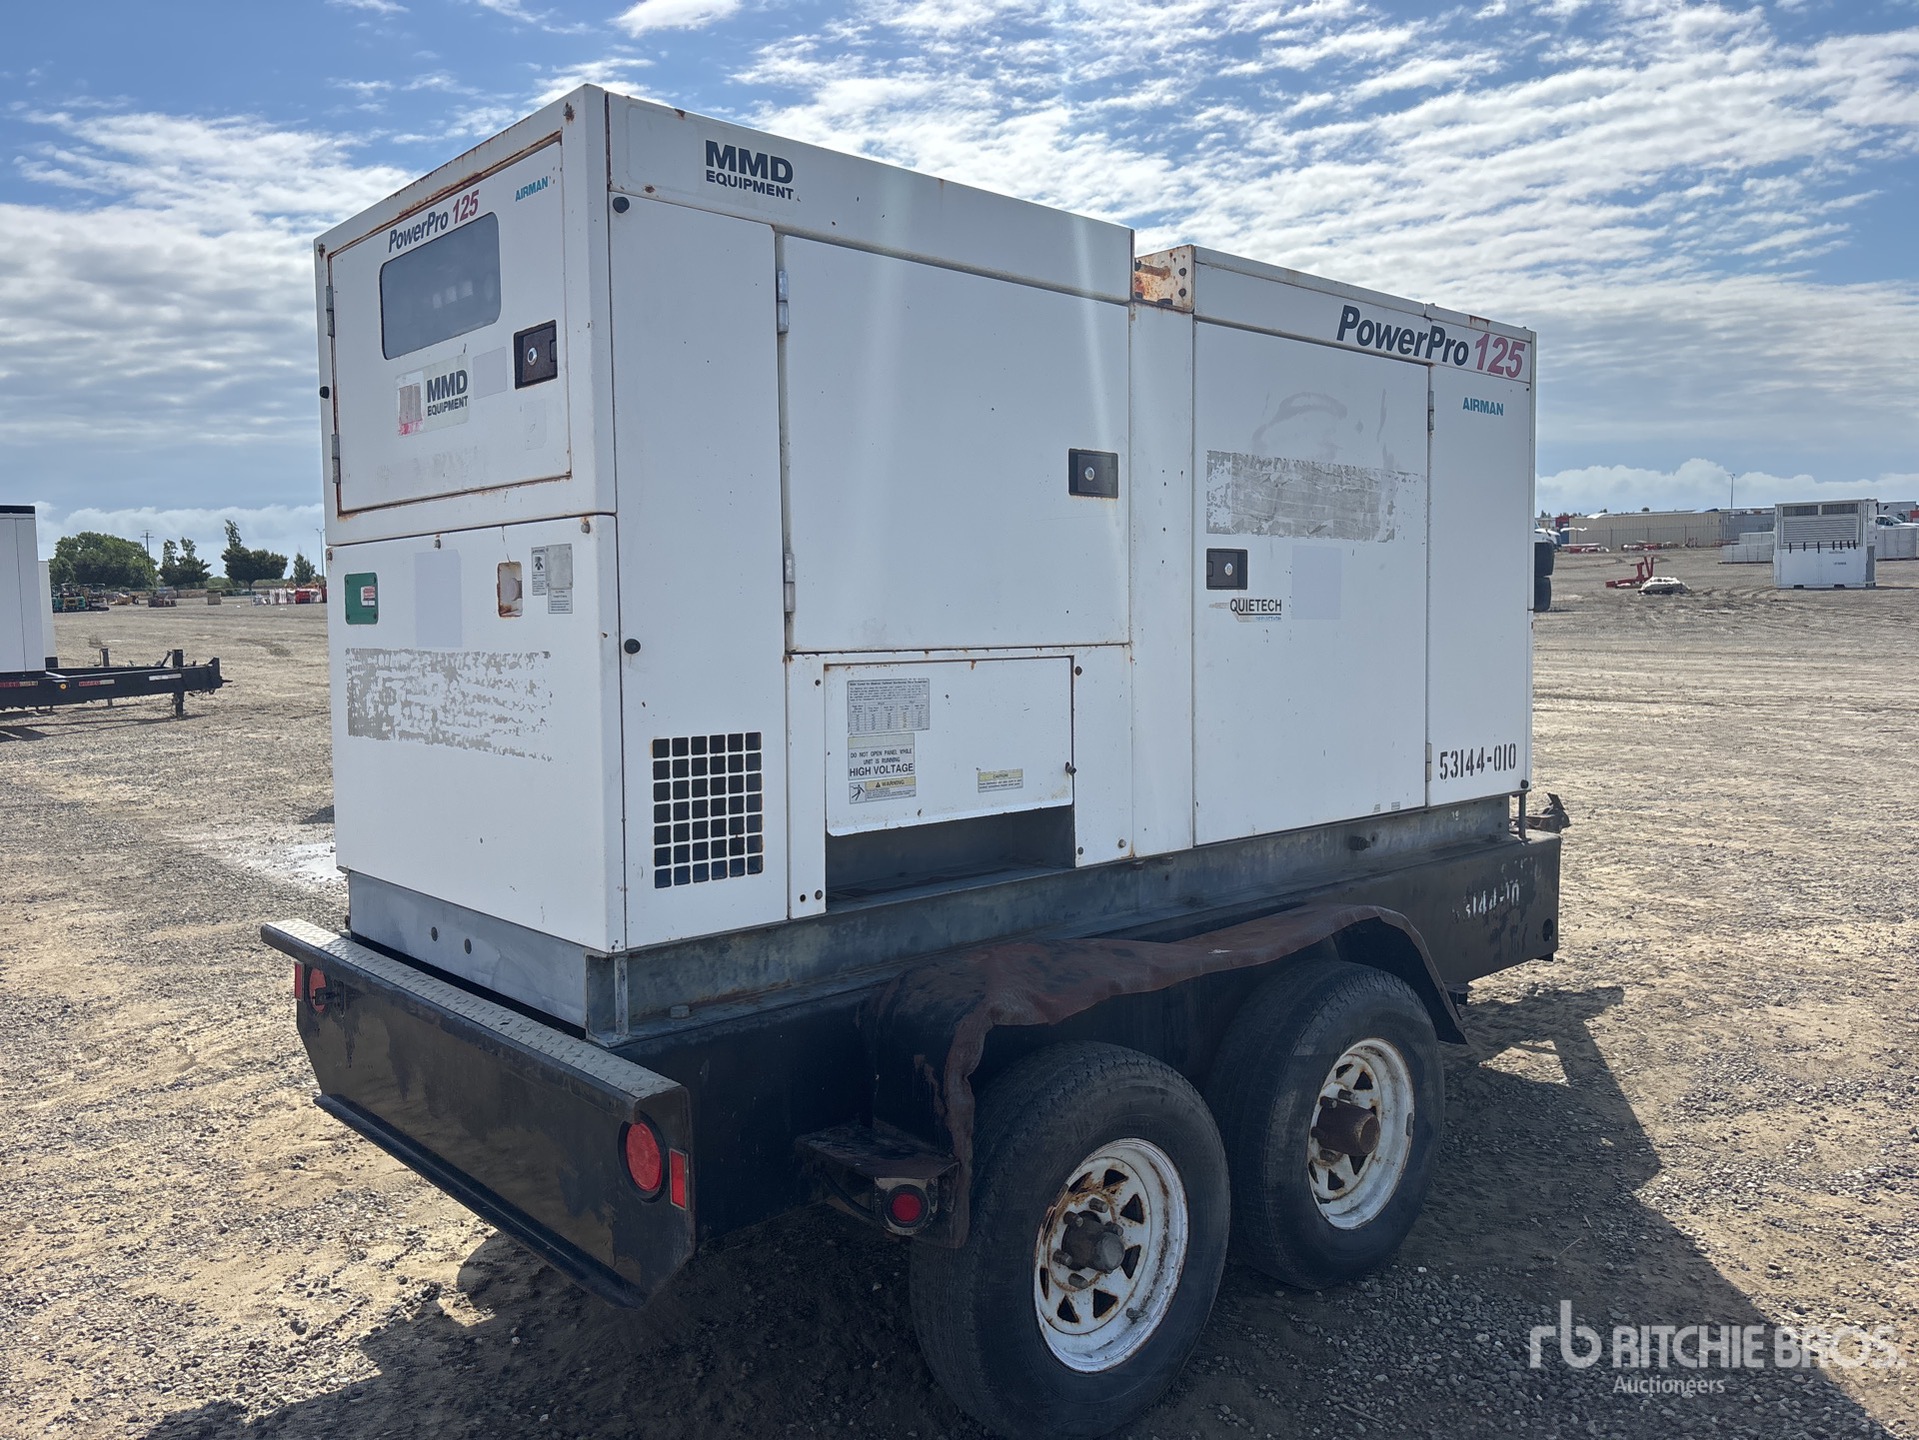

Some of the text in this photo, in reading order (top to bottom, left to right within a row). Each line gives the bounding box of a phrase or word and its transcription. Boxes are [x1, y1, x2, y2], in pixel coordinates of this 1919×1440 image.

[705, 139, 794, 184] MMD
[515, 176, 549, 202] AIRMAN
[705, 169, 795, 200] EQUIPMENT
[388, 189, 480, 253] PowerPro 125
[1336, 304, 1526, 379] PowerPro 125
[426, 369, 468, 403] MMD
[427, 395, 469, 417] EQUIPMENT
[1462, 397, 1504, 417] AIRMAN
[1230, 598, 1282, 613] QUIETECH
[849, 763, 914, 777] HIGH VOLTAGE
[1439, 742, 1517, 780] 53144-010
